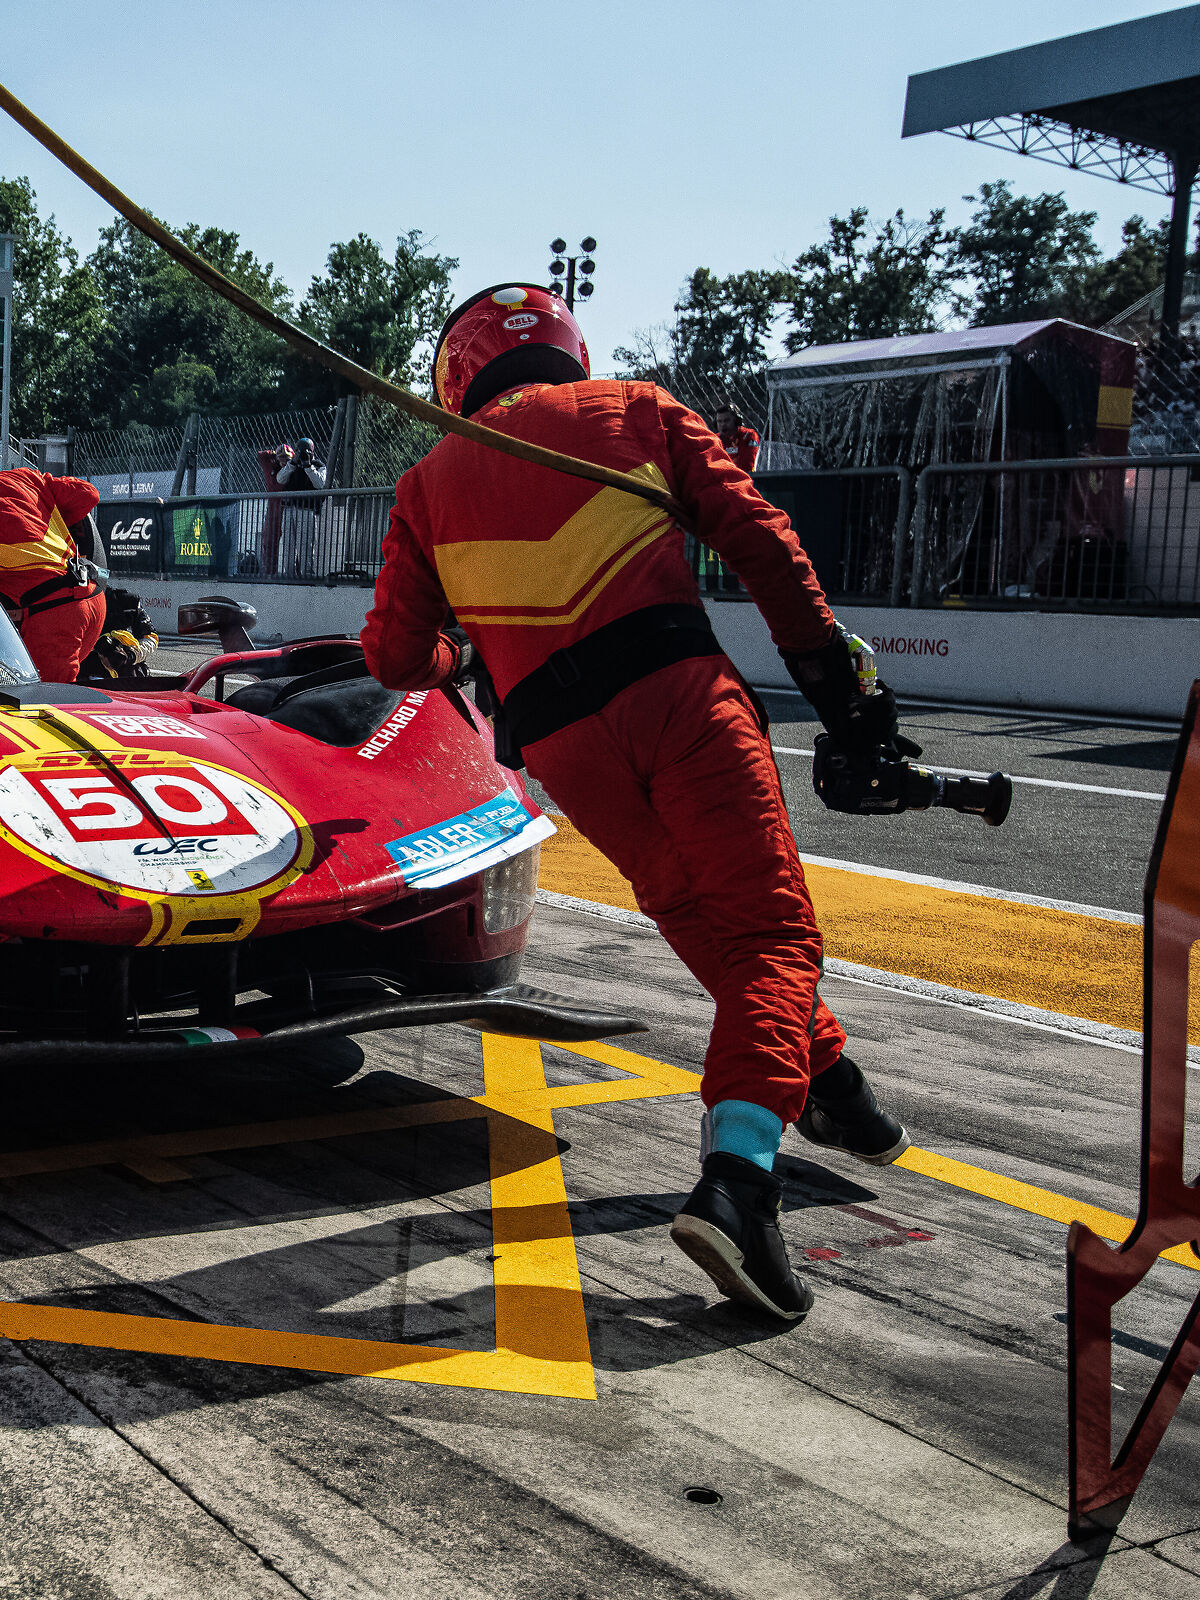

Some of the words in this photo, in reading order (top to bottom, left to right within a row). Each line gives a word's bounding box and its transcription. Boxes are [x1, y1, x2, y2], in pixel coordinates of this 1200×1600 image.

[508, 316, 534, 327] BELL
[110, 517, 153, 540] WEC
[180, 542, 213, 556] ROLEX
[871, 636, 949, 656] SMOKING
[112, 722, 199, 737] CAR
[357, 705, 418, 760] RICHARD
[35, 754, 166, 768] DHL
[40, 774, 228, 831] 50
[133, 838, 218, 856] WEC
[398, 823, 485, 865] ADLER
